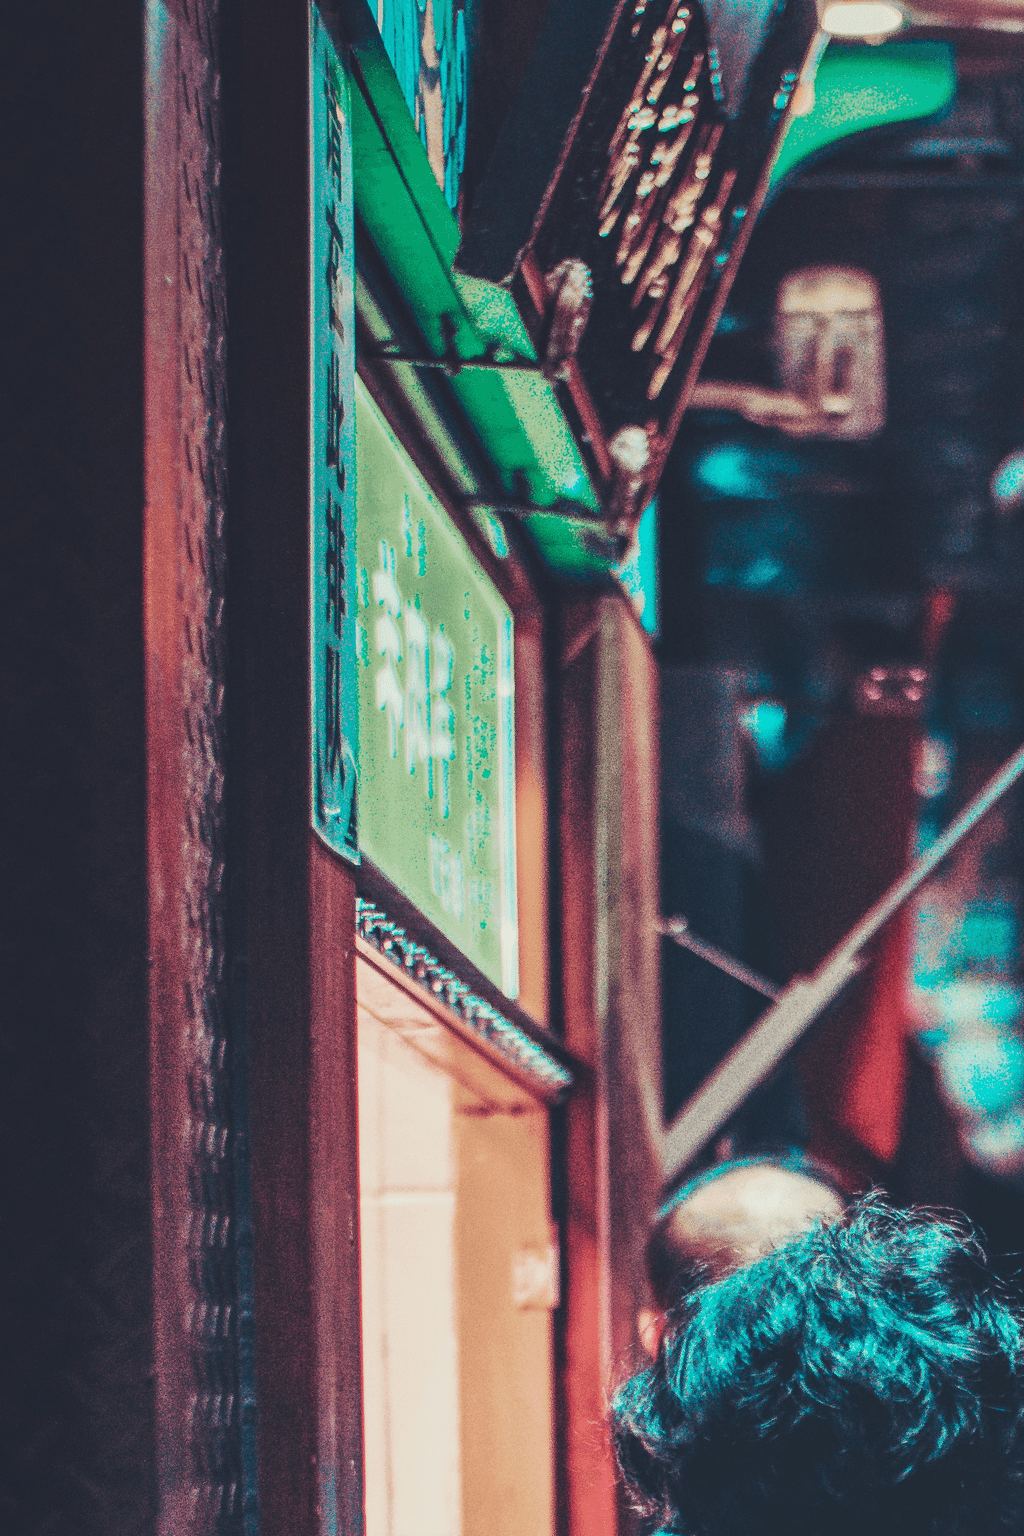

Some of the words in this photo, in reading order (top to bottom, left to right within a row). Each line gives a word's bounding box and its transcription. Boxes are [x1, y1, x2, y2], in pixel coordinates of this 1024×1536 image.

[324, 50, 346, 790] 请在此排队
